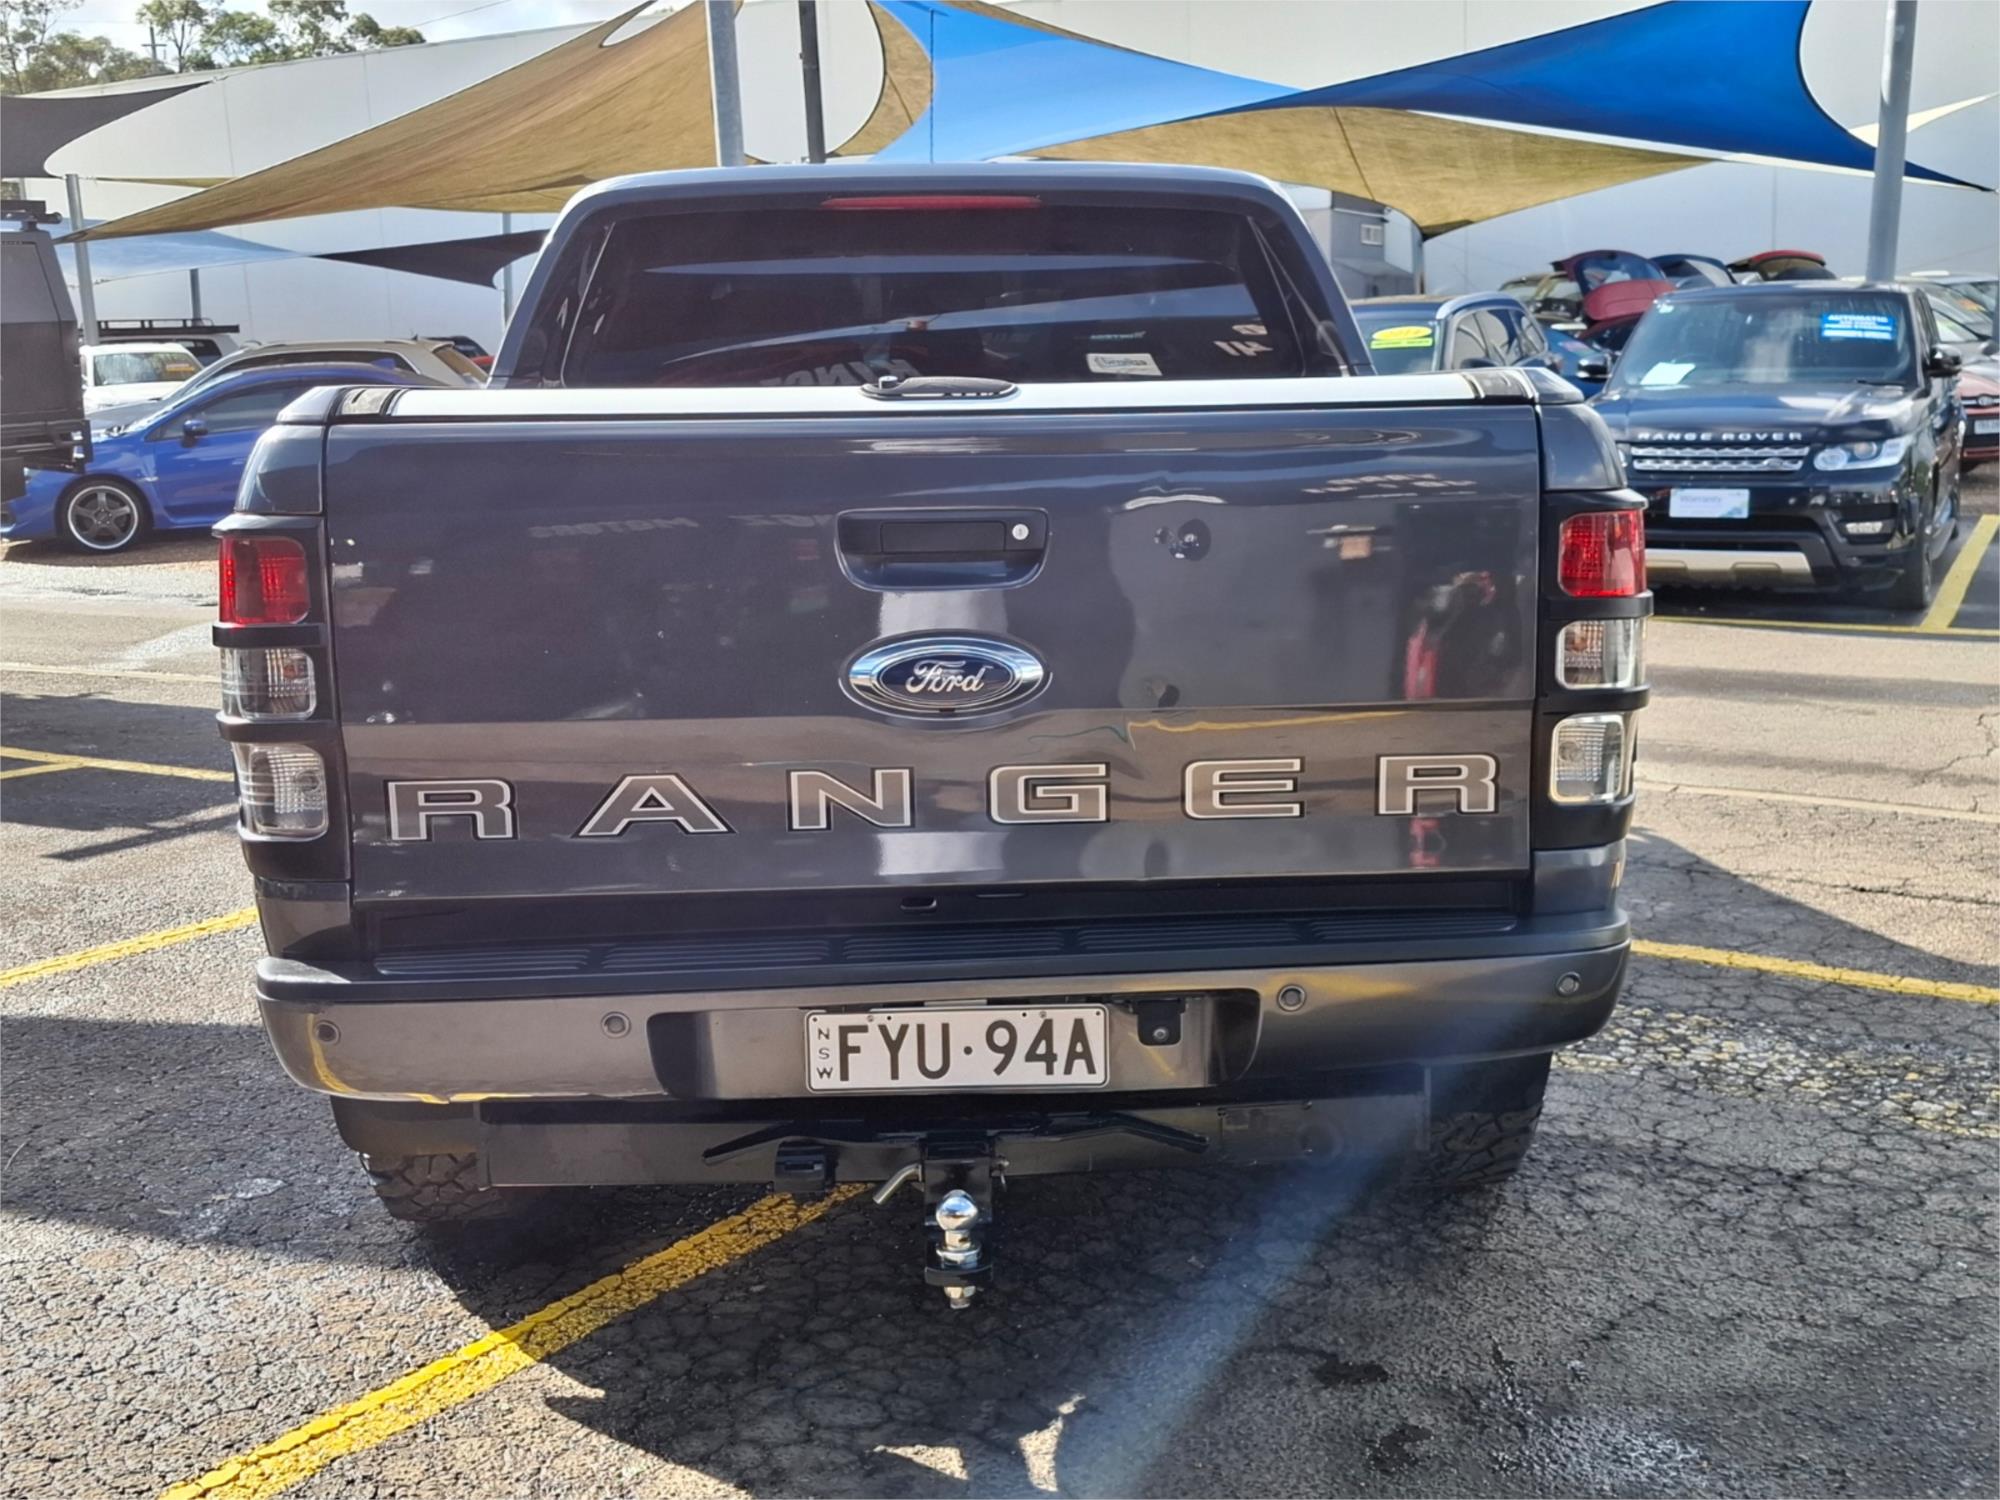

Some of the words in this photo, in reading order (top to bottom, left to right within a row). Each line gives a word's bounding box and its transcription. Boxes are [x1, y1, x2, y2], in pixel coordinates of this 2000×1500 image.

[1637, 432, 1713, 442] RANGE
[1721, 432, 1803, 442] ROVER
[904, 659, 995, 693] Ford
[383, 753, 1499, 843] RANGER
